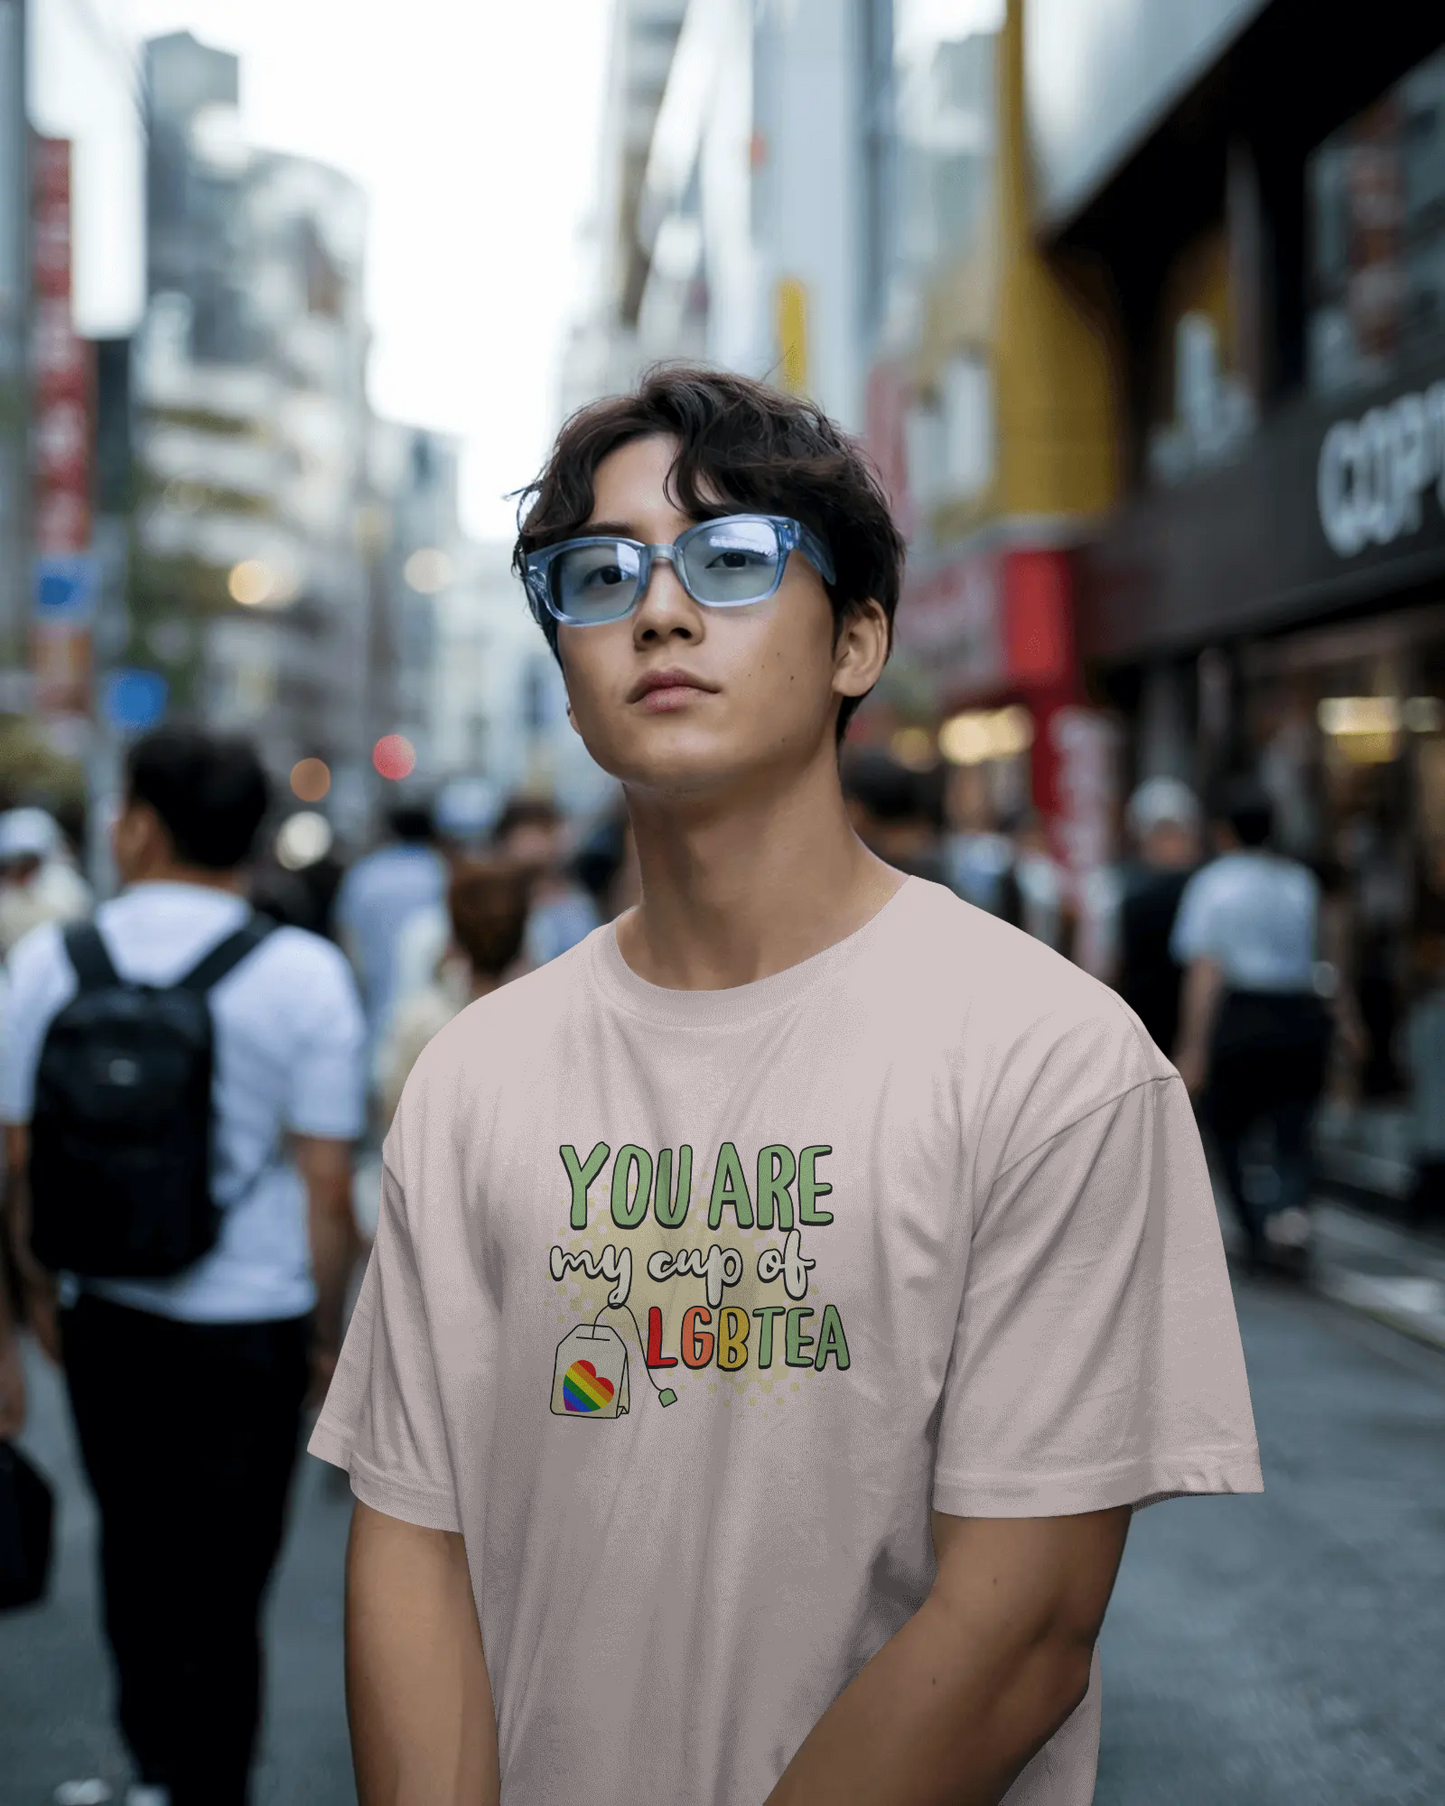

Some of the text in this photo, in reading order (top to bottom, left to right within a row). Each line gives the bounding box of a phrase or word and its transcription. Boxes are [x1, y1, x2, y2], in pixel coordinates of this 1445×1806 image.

[559, 1141, 834, 1231] YOU ARE
[550, 1228, 816, 1309] my cup of
[646, 1304, 851, 1371] LGBTEA
